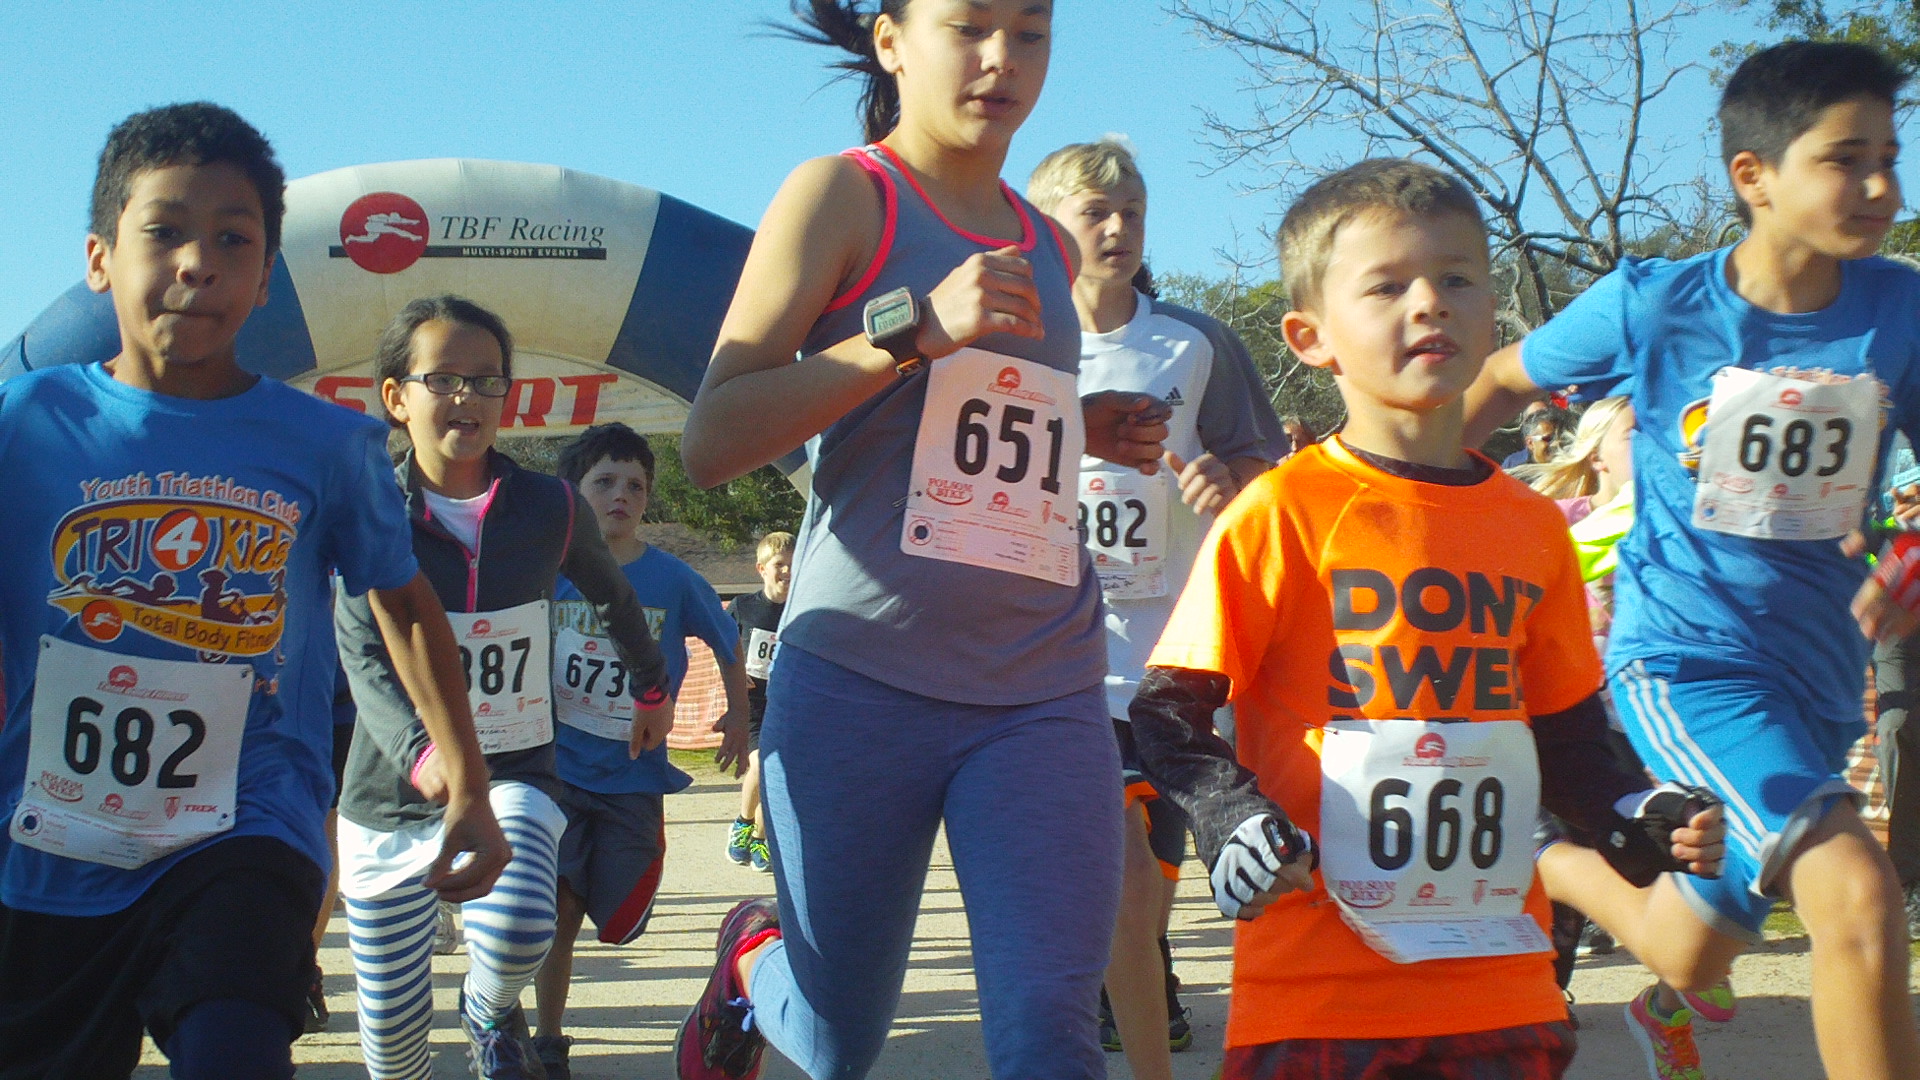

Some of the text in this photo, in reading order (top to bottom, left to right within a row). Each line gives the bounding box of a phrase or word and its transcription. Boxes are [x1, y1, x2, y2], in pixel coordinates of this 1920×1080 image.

[440, 216, 605, 247] TBF Racing
[462, 247, 579, 257] MULTI-SPORT EVENTS
[314, 374, 619, 428] SRT
[954, 397, 1063, 495] 651
[1740, 413, 1851, 477] 683
[80, 471, 301, 525] Youth Triathlon Club
[72, 515, 291, 573] TRI 4 Kids
[132, 607, 279, 650] Total Body Fitne
[566, 652, 628, 698] 673
[1328, 643, 1524, 710] SWE
[64, 696, 206, 788] 682
[1369, 777, 1503, 872] 668
